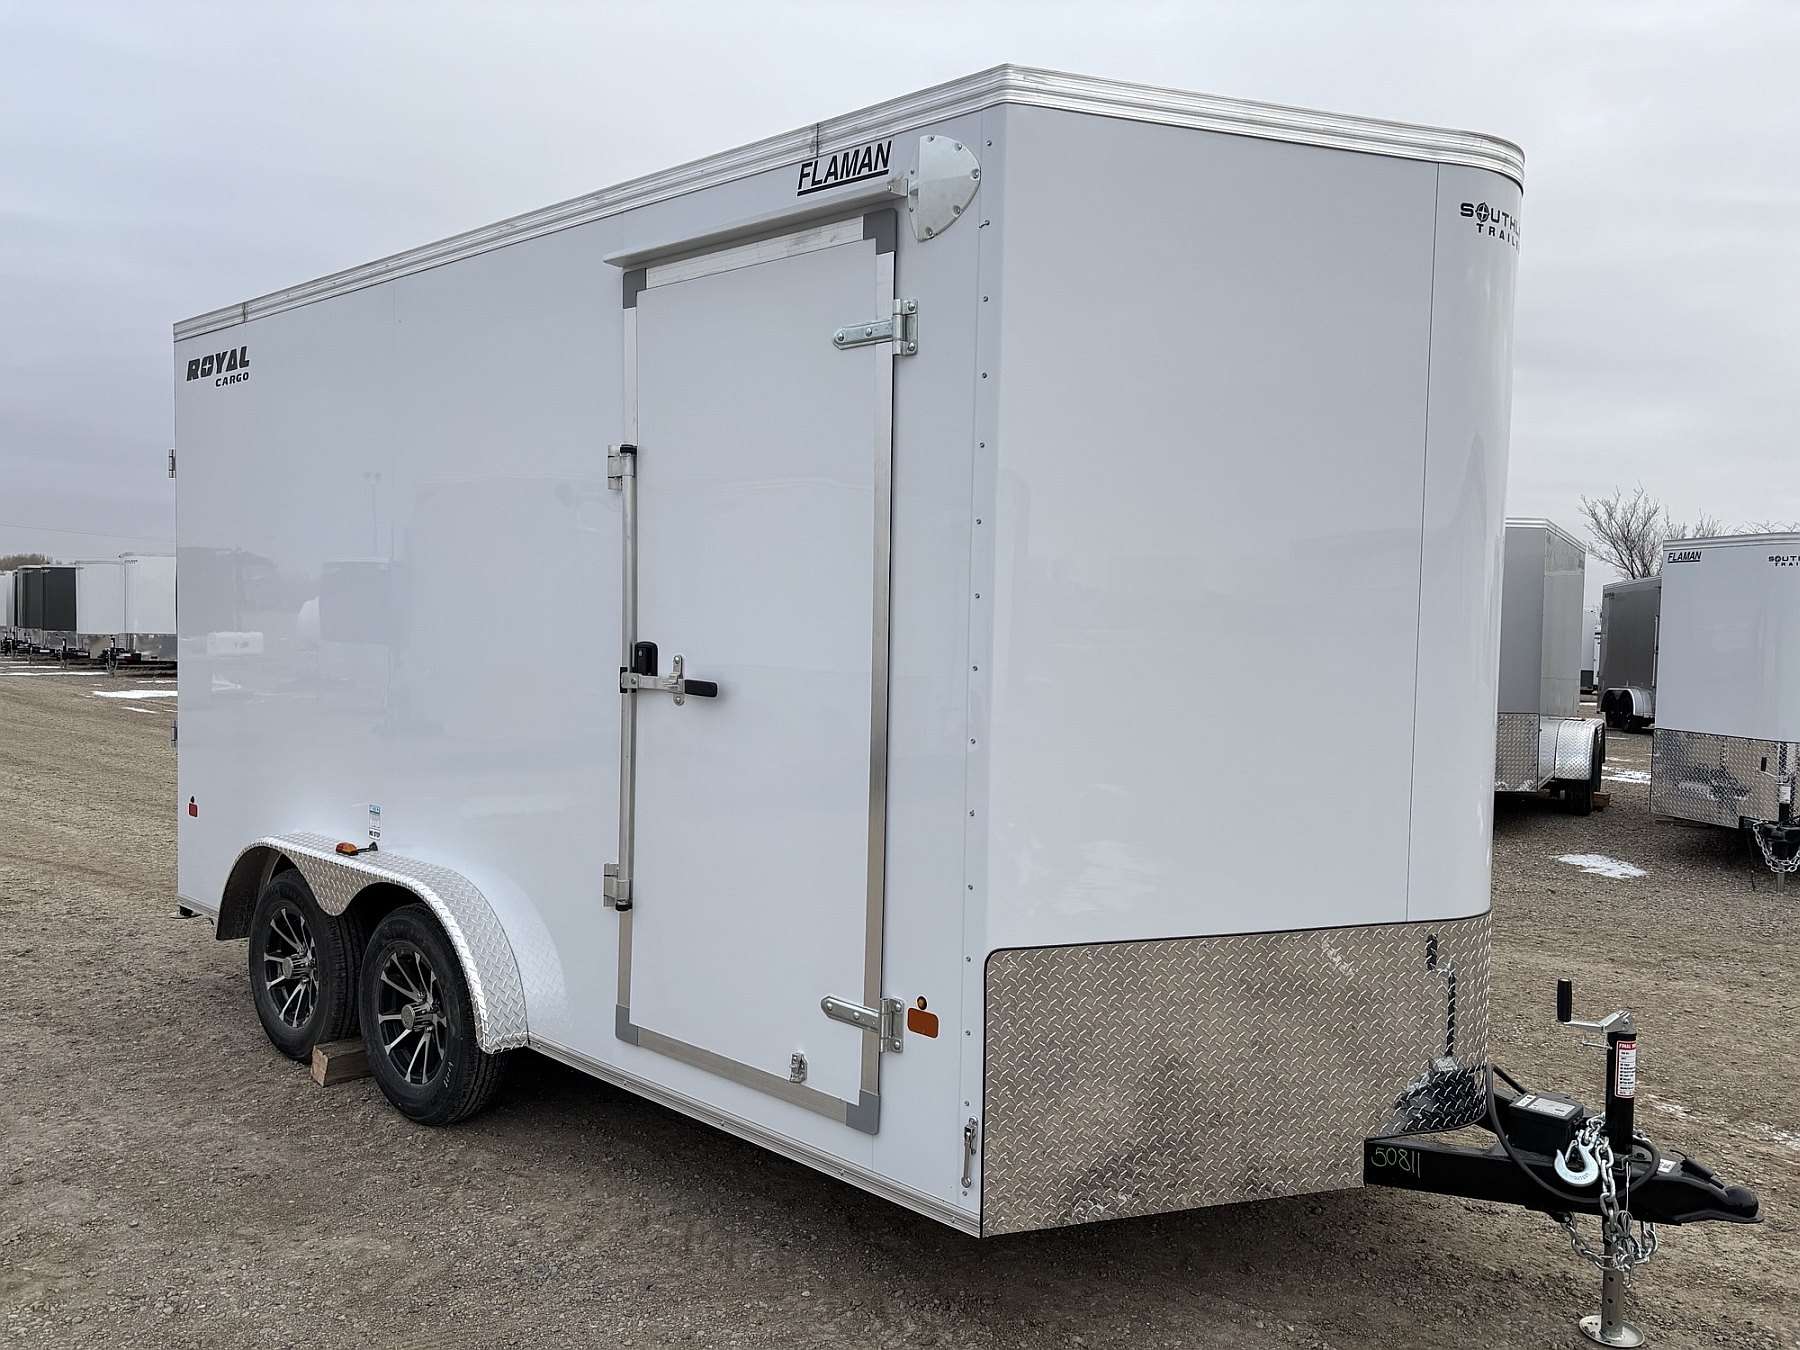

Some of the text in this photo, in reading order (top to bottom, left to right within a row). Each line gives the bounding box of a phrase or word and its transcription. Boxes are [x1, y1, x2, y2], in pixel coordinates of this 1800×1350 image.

[798, 140, 892, 190] FLAMAN
[187, 345, 250, 382] ROYAL
[215, 372, 249, 387] CARGO
[1667, 551, 1702, 562] FLAMAN
[1371, 1147, 1420, 1179] 50811
